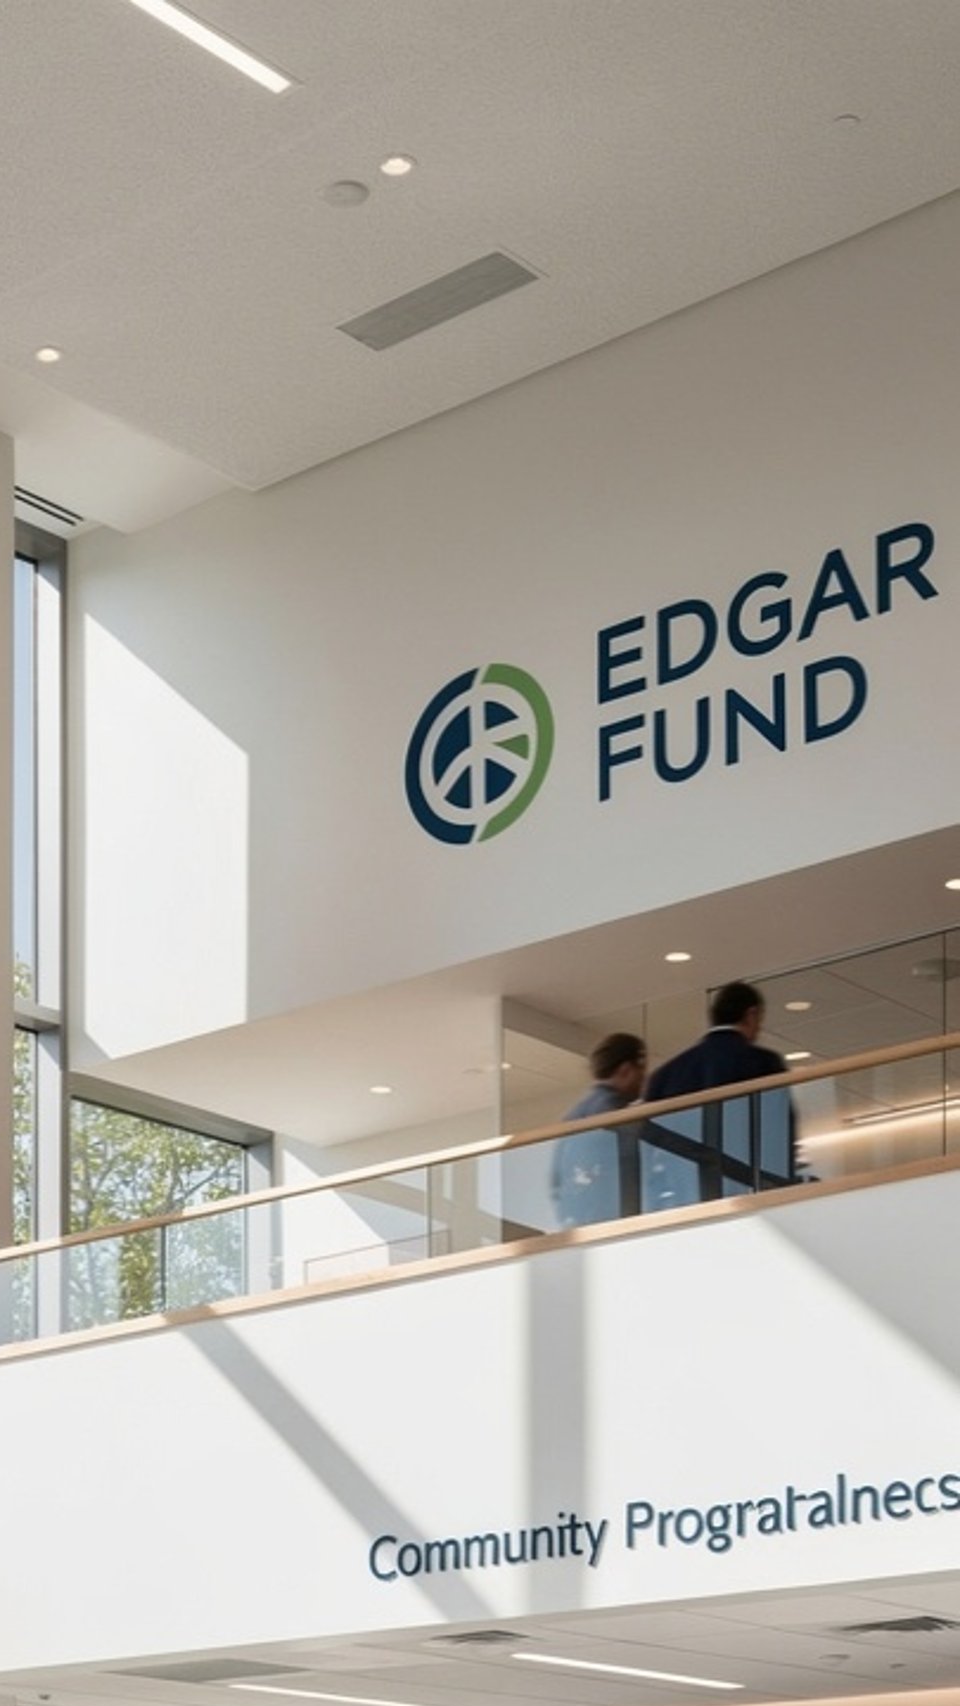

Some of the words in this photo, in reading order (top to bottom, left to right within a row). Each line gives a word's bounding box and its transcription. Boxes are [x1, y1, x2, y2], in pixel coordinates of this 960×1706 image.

[597, 522, 939, 705] EDGAR
[598, 655, 869, 802] FUND
[369, 1511, 608, 1581] Community
